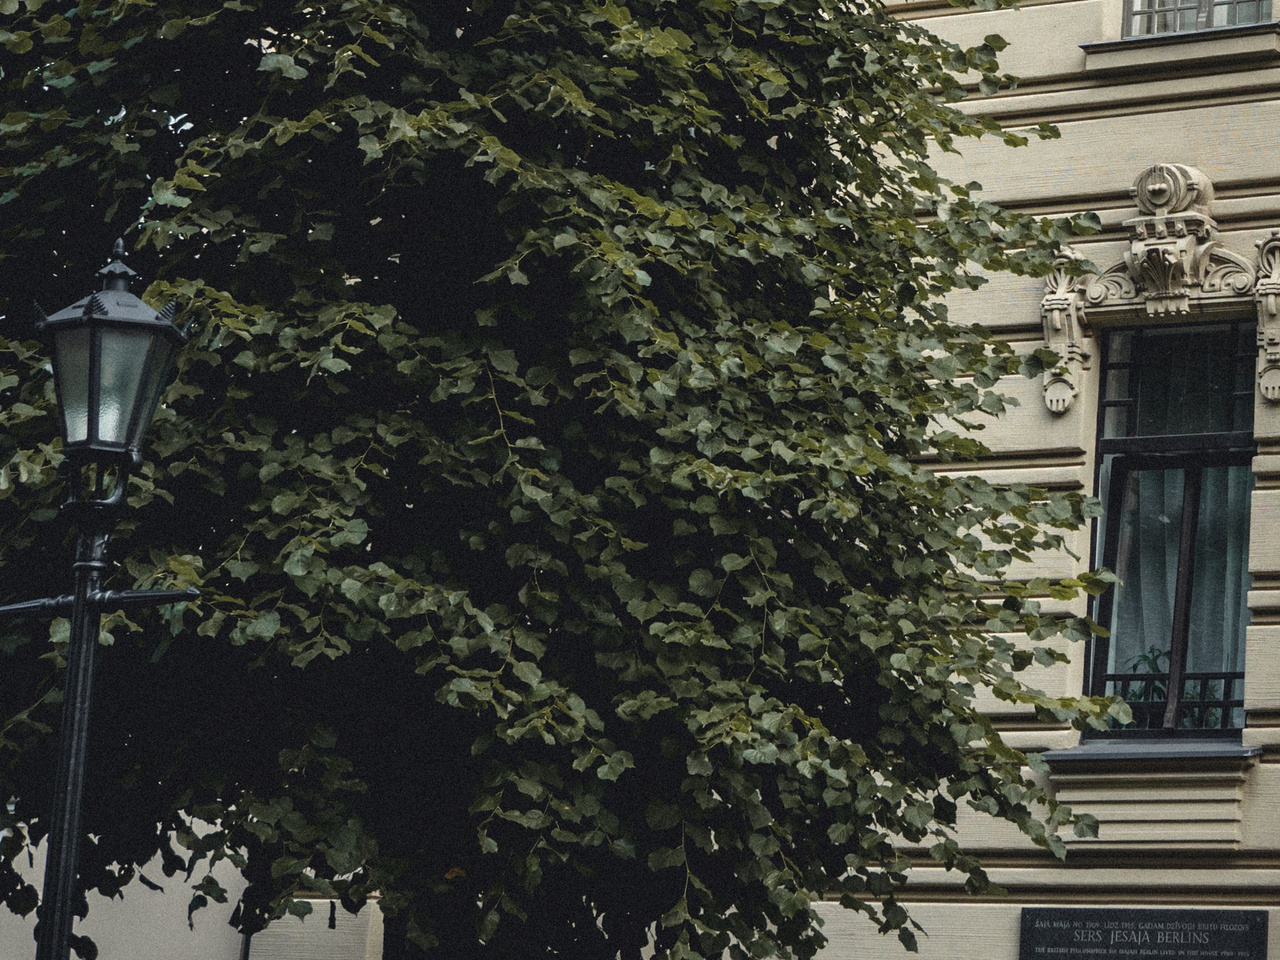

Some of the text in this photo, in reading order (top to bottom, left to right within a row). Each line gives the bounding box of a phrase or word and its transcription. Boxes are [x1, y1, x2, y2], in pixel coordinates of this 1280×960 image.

[1073, 930, 1210, 945] SERS JESAJA BERLINS
